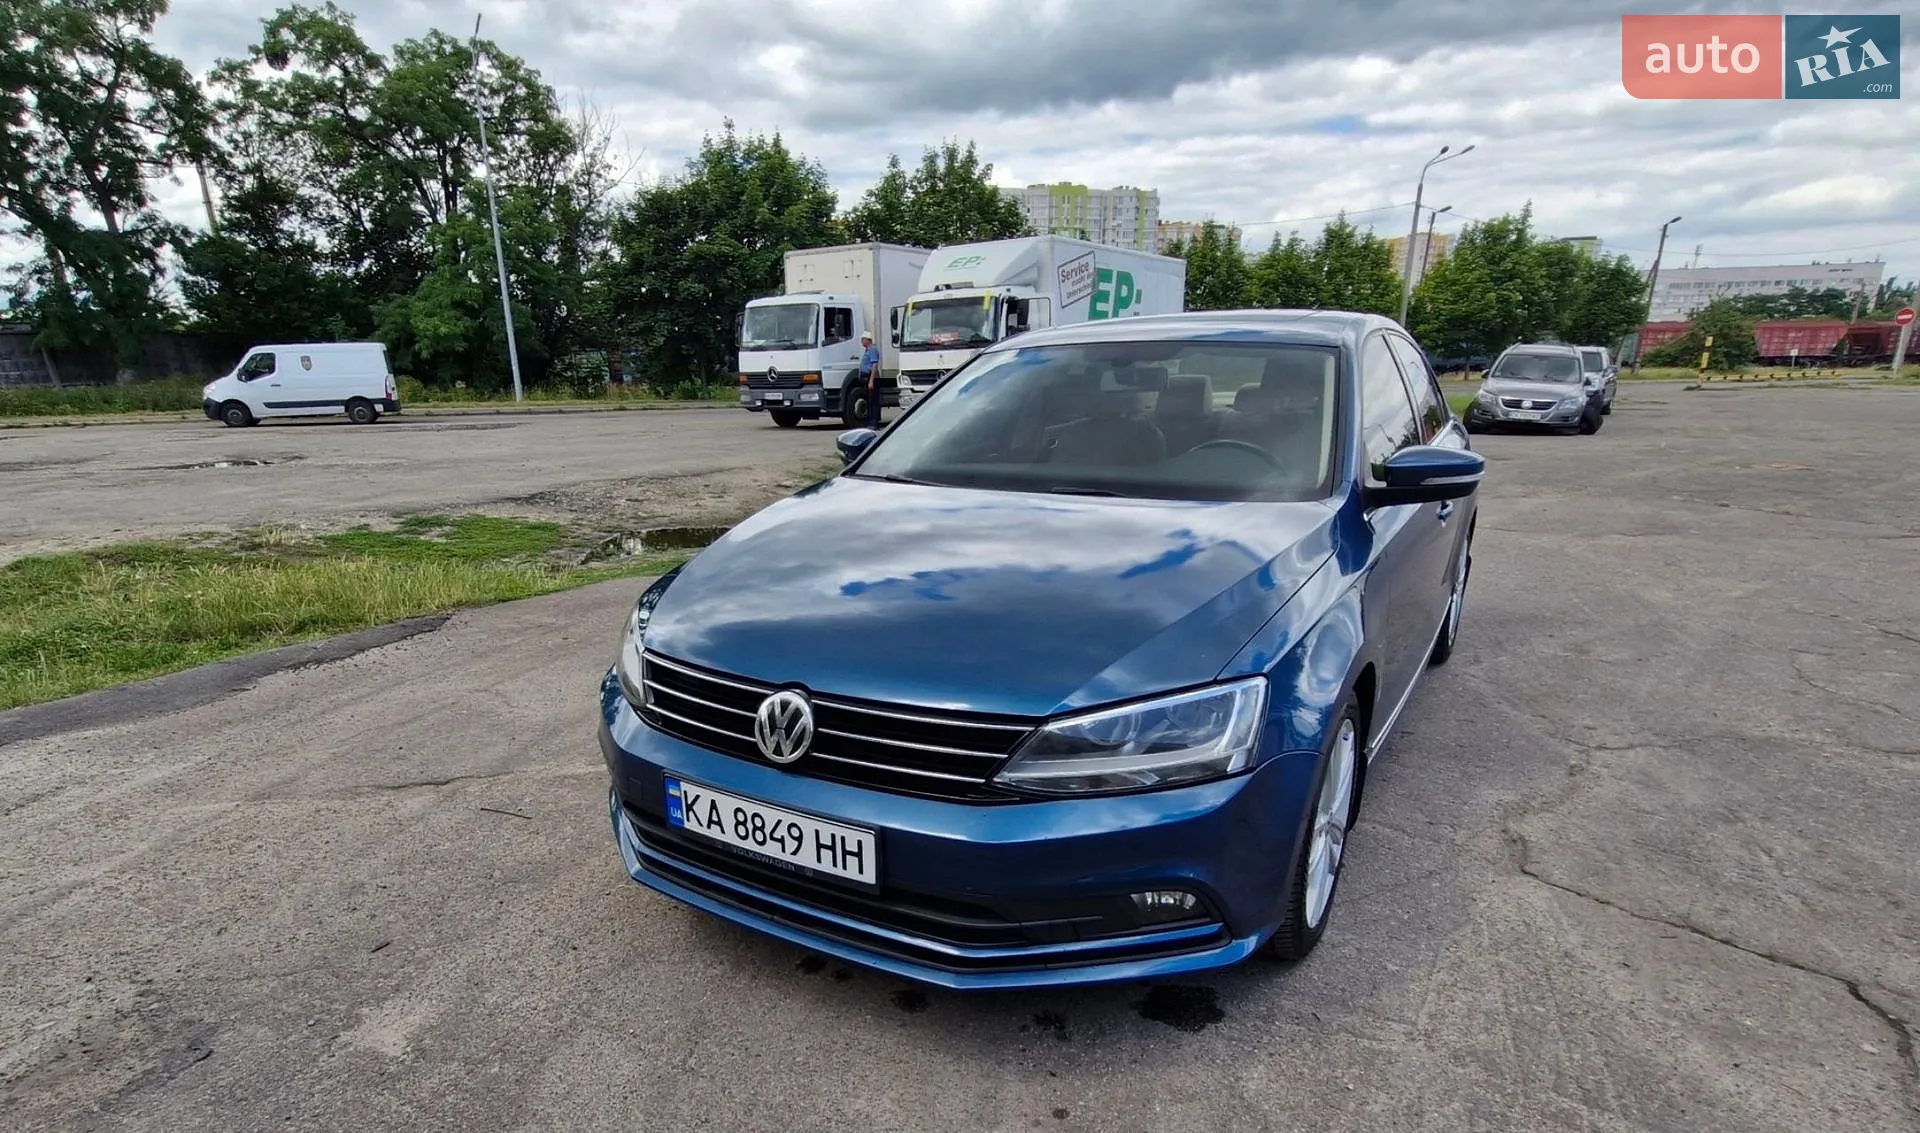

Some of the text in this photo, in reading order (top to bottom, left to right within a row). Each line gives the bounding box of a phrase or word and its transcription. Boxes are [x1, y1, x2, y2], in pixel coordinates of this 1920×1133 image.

[1060, 261, 1090, 283] Service
[670, 806, 682, 819] UA
[683, 790, 865, 875] KA 8849 HH
